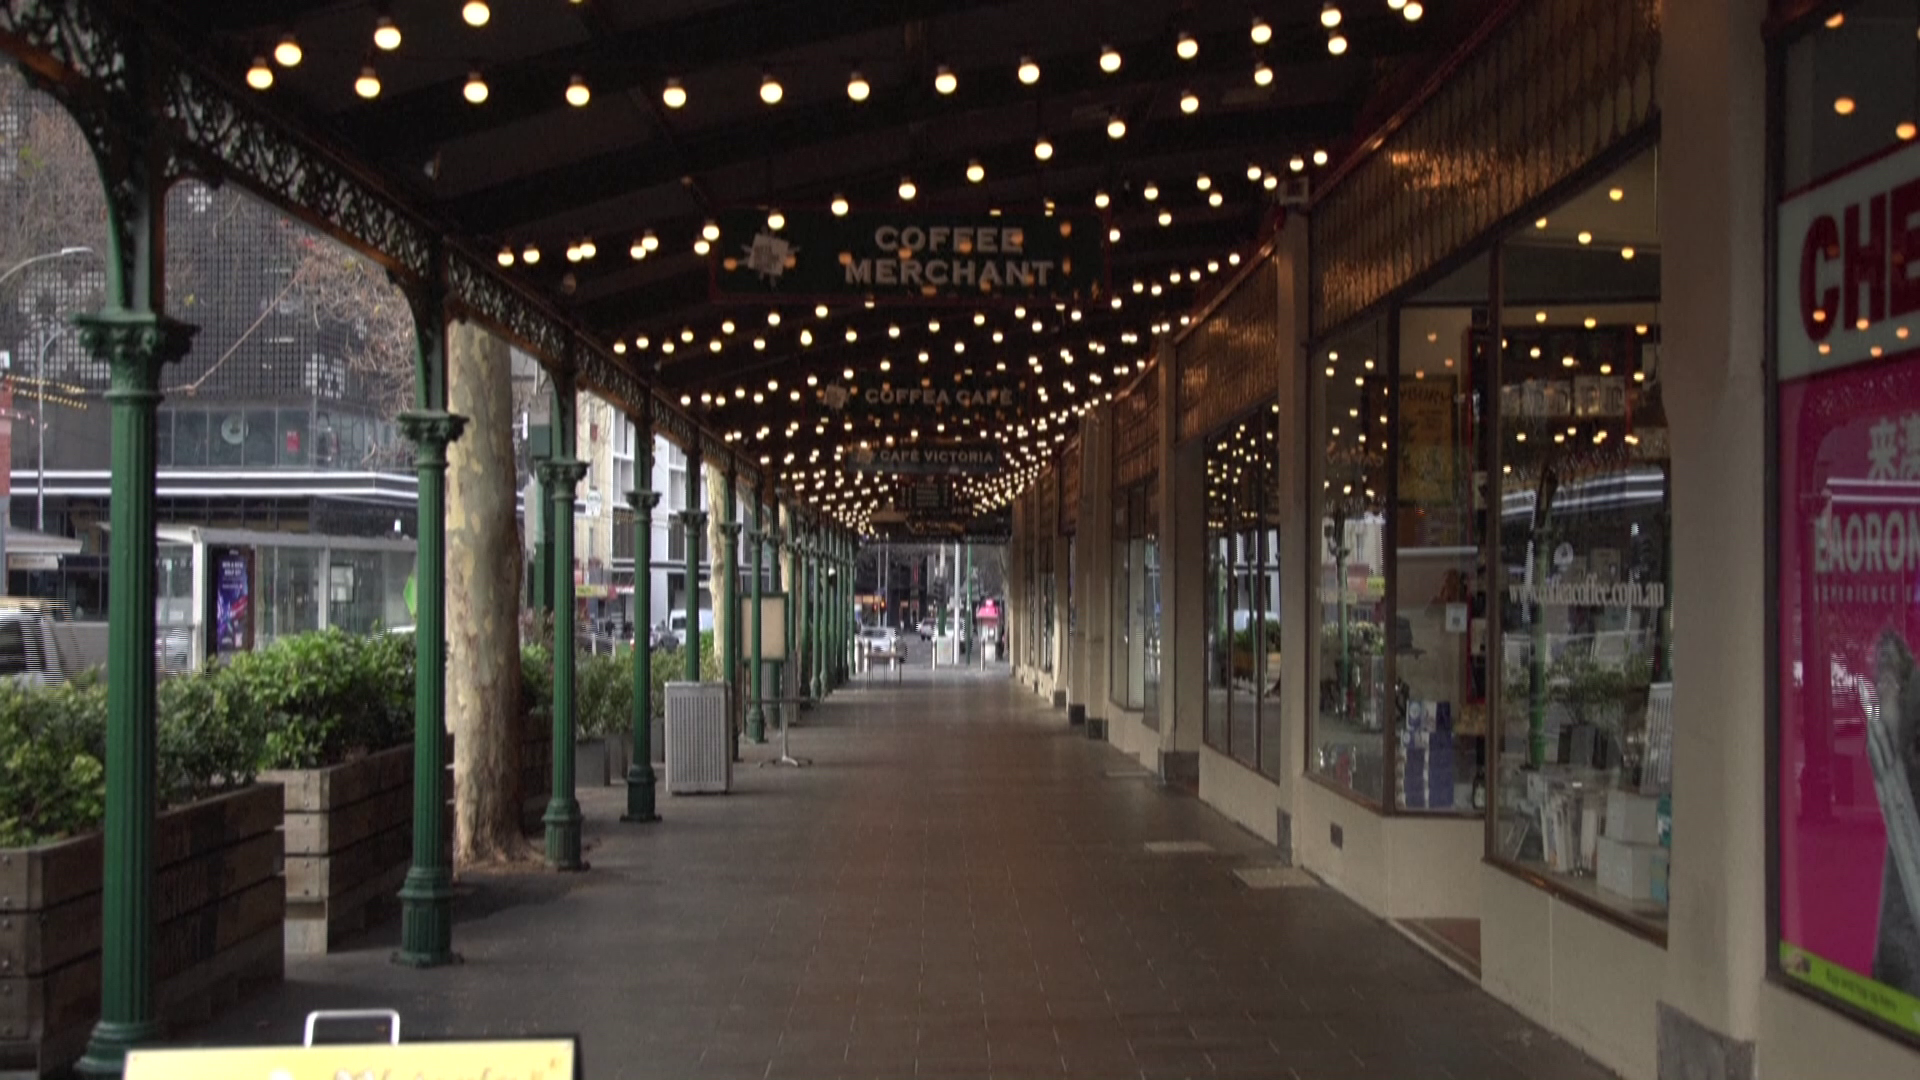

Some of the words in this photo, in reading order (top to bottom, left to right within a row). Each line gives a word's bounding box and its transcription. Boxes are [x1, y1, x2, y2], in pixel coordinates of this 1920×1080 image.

[874, 225, 1023, 254] COFFEE
[845, 258, 1054, 286] MERCHANT
[1800, 178, 1920, 341] CHE
[865, 388, 950, 404] COFFEA
[956, 385, 1013, 406] CAFÉ
[880, 449, 920, 463] CAFÉ
[924, 450, 994, 463] VICTORIA
